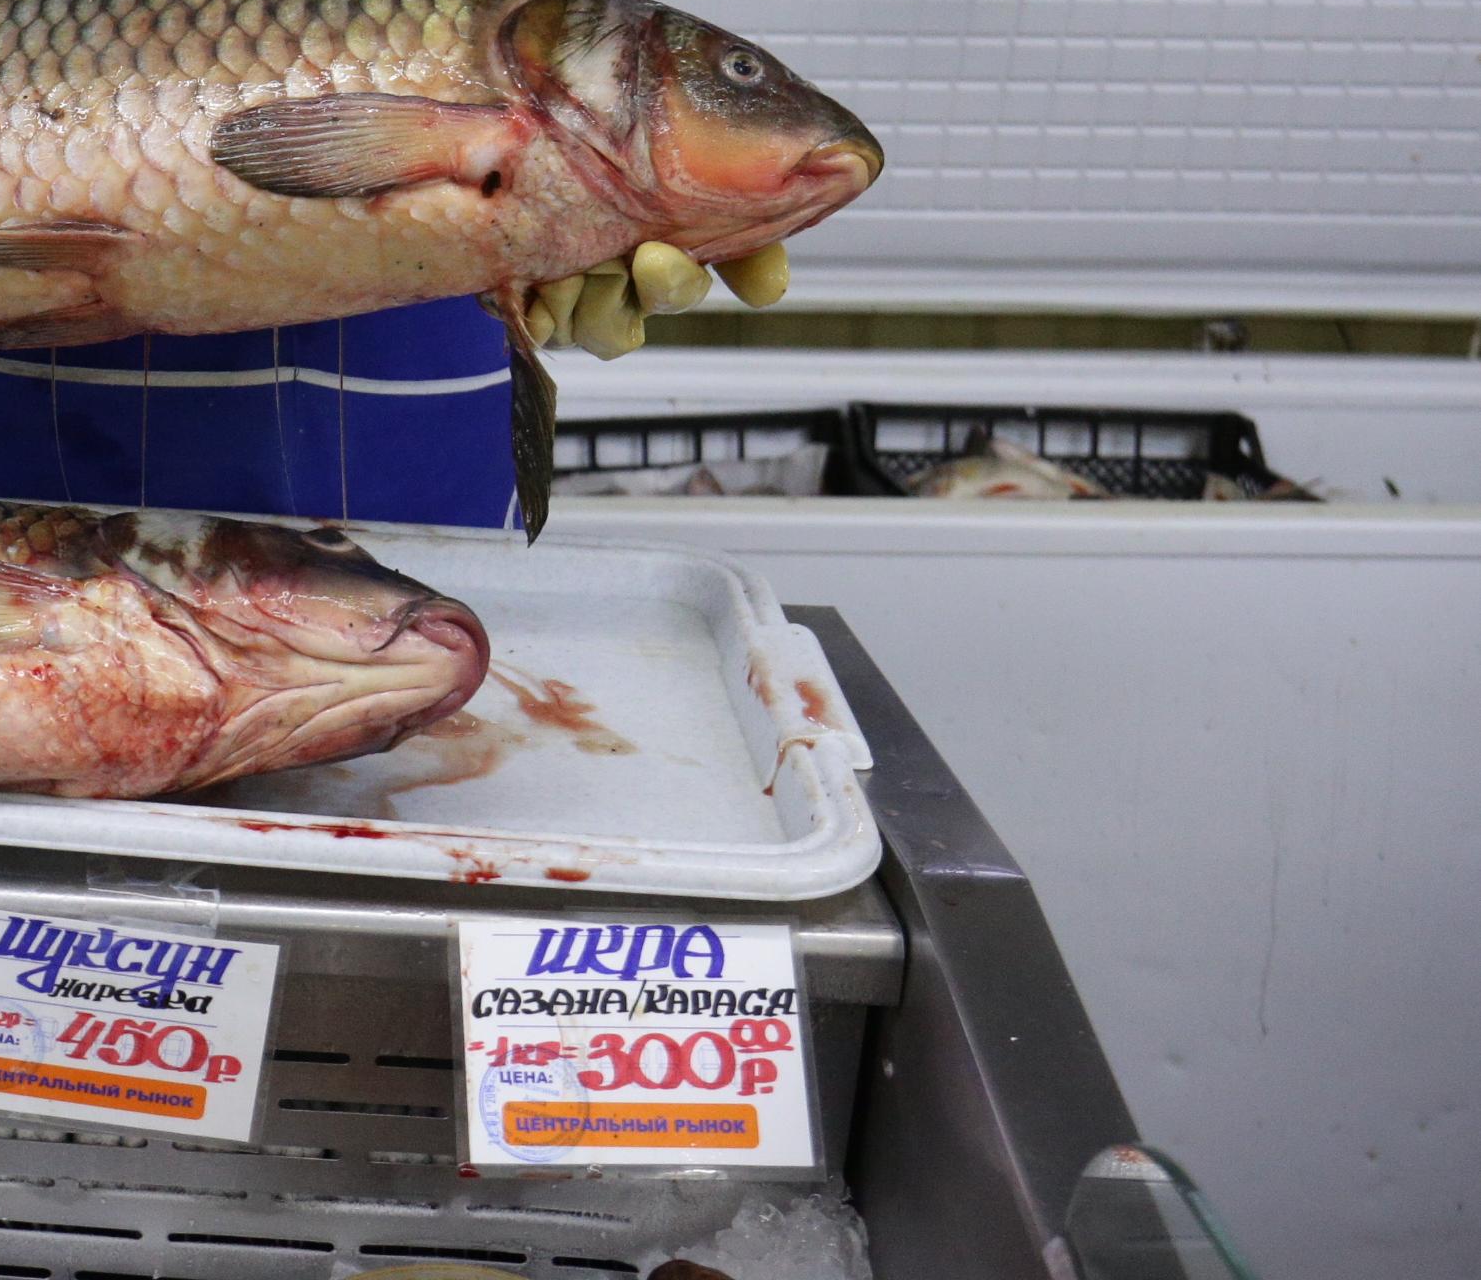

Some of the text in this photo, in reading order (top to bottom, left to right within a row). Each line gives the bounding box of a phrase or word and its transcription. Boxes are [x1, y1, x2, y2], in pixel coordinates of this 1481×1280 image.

[525, 924, 725, 981] ИКРА
[56, 1011, 210, 1073] 450
[577, 1031, 737, 1091] 300
[499, 1070, 554, 1086] ЦЕНА:
[125, 1089, 195, 1109] РЫНОК
[515, 1115, 746, 1135] ЦЕНТРАЛЬНЫЙ РЫНОК
